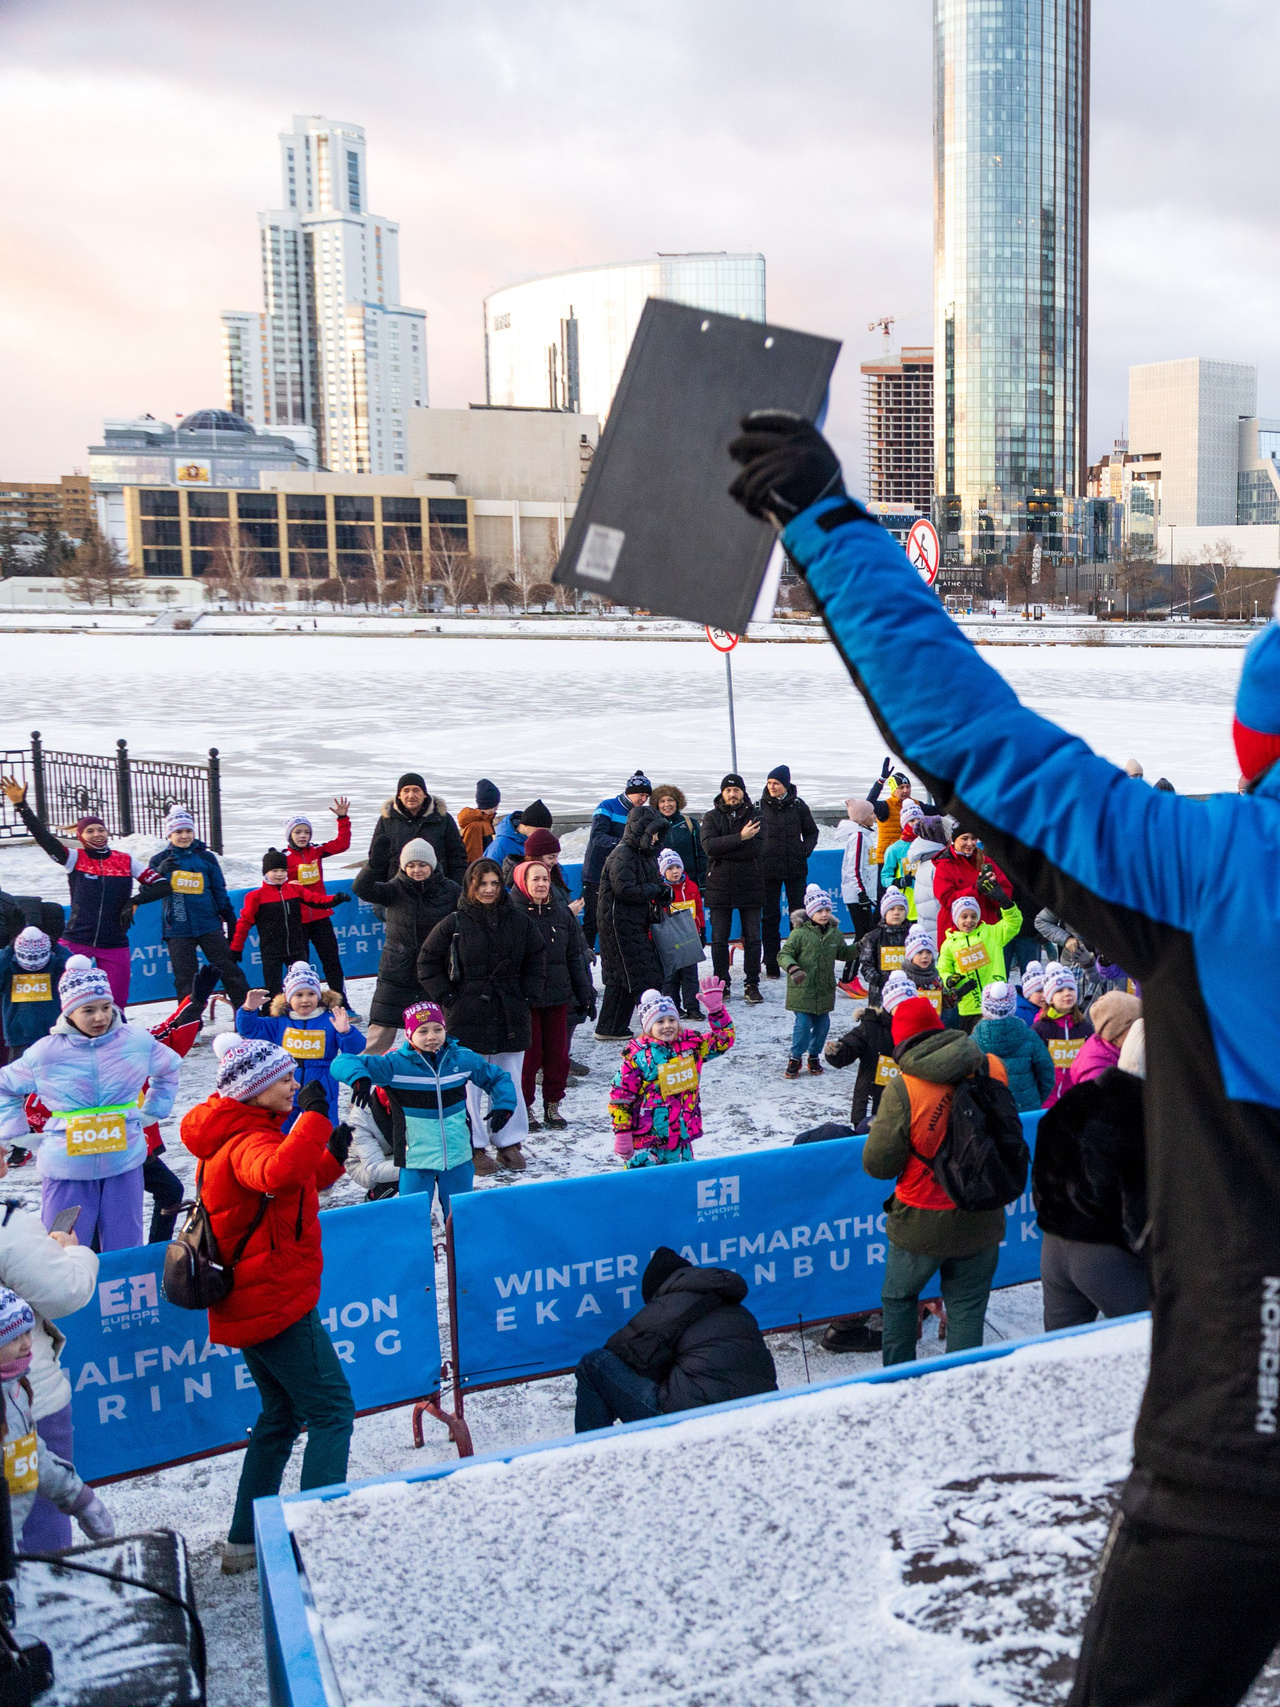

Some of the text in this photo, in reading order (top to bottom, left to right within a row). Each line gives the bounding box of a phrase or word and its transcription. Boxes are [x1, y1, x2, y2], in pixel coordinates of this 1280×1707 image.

[302, 870, 319, 879] 514
[177, 878, 200, 888] 5110
[885, 954, 906, 964] 508
[961, 951, 985, 966] 5153
[16, 982, 48, 994] 5043
[404, 1002, 438, 1019] RUSSIA
[286, 1037, 321, 1050] 5084
[666, 1068, 694, 1085] 5138
[880, 1066, 899, 1078] 50
[72, 1126, 122, 1144] 5044
[697, 1205, 740, 1216] EUROPE
[697, 1211, 740, 1223] ASIA
[494, 1212, 888, 1298] WINTER ALFMARATHO
[101, 1308, 160, 1326] EUROPE
[102, 1316, 160, 1334] ASIA
[15, 1451, 39, 1477] 50
